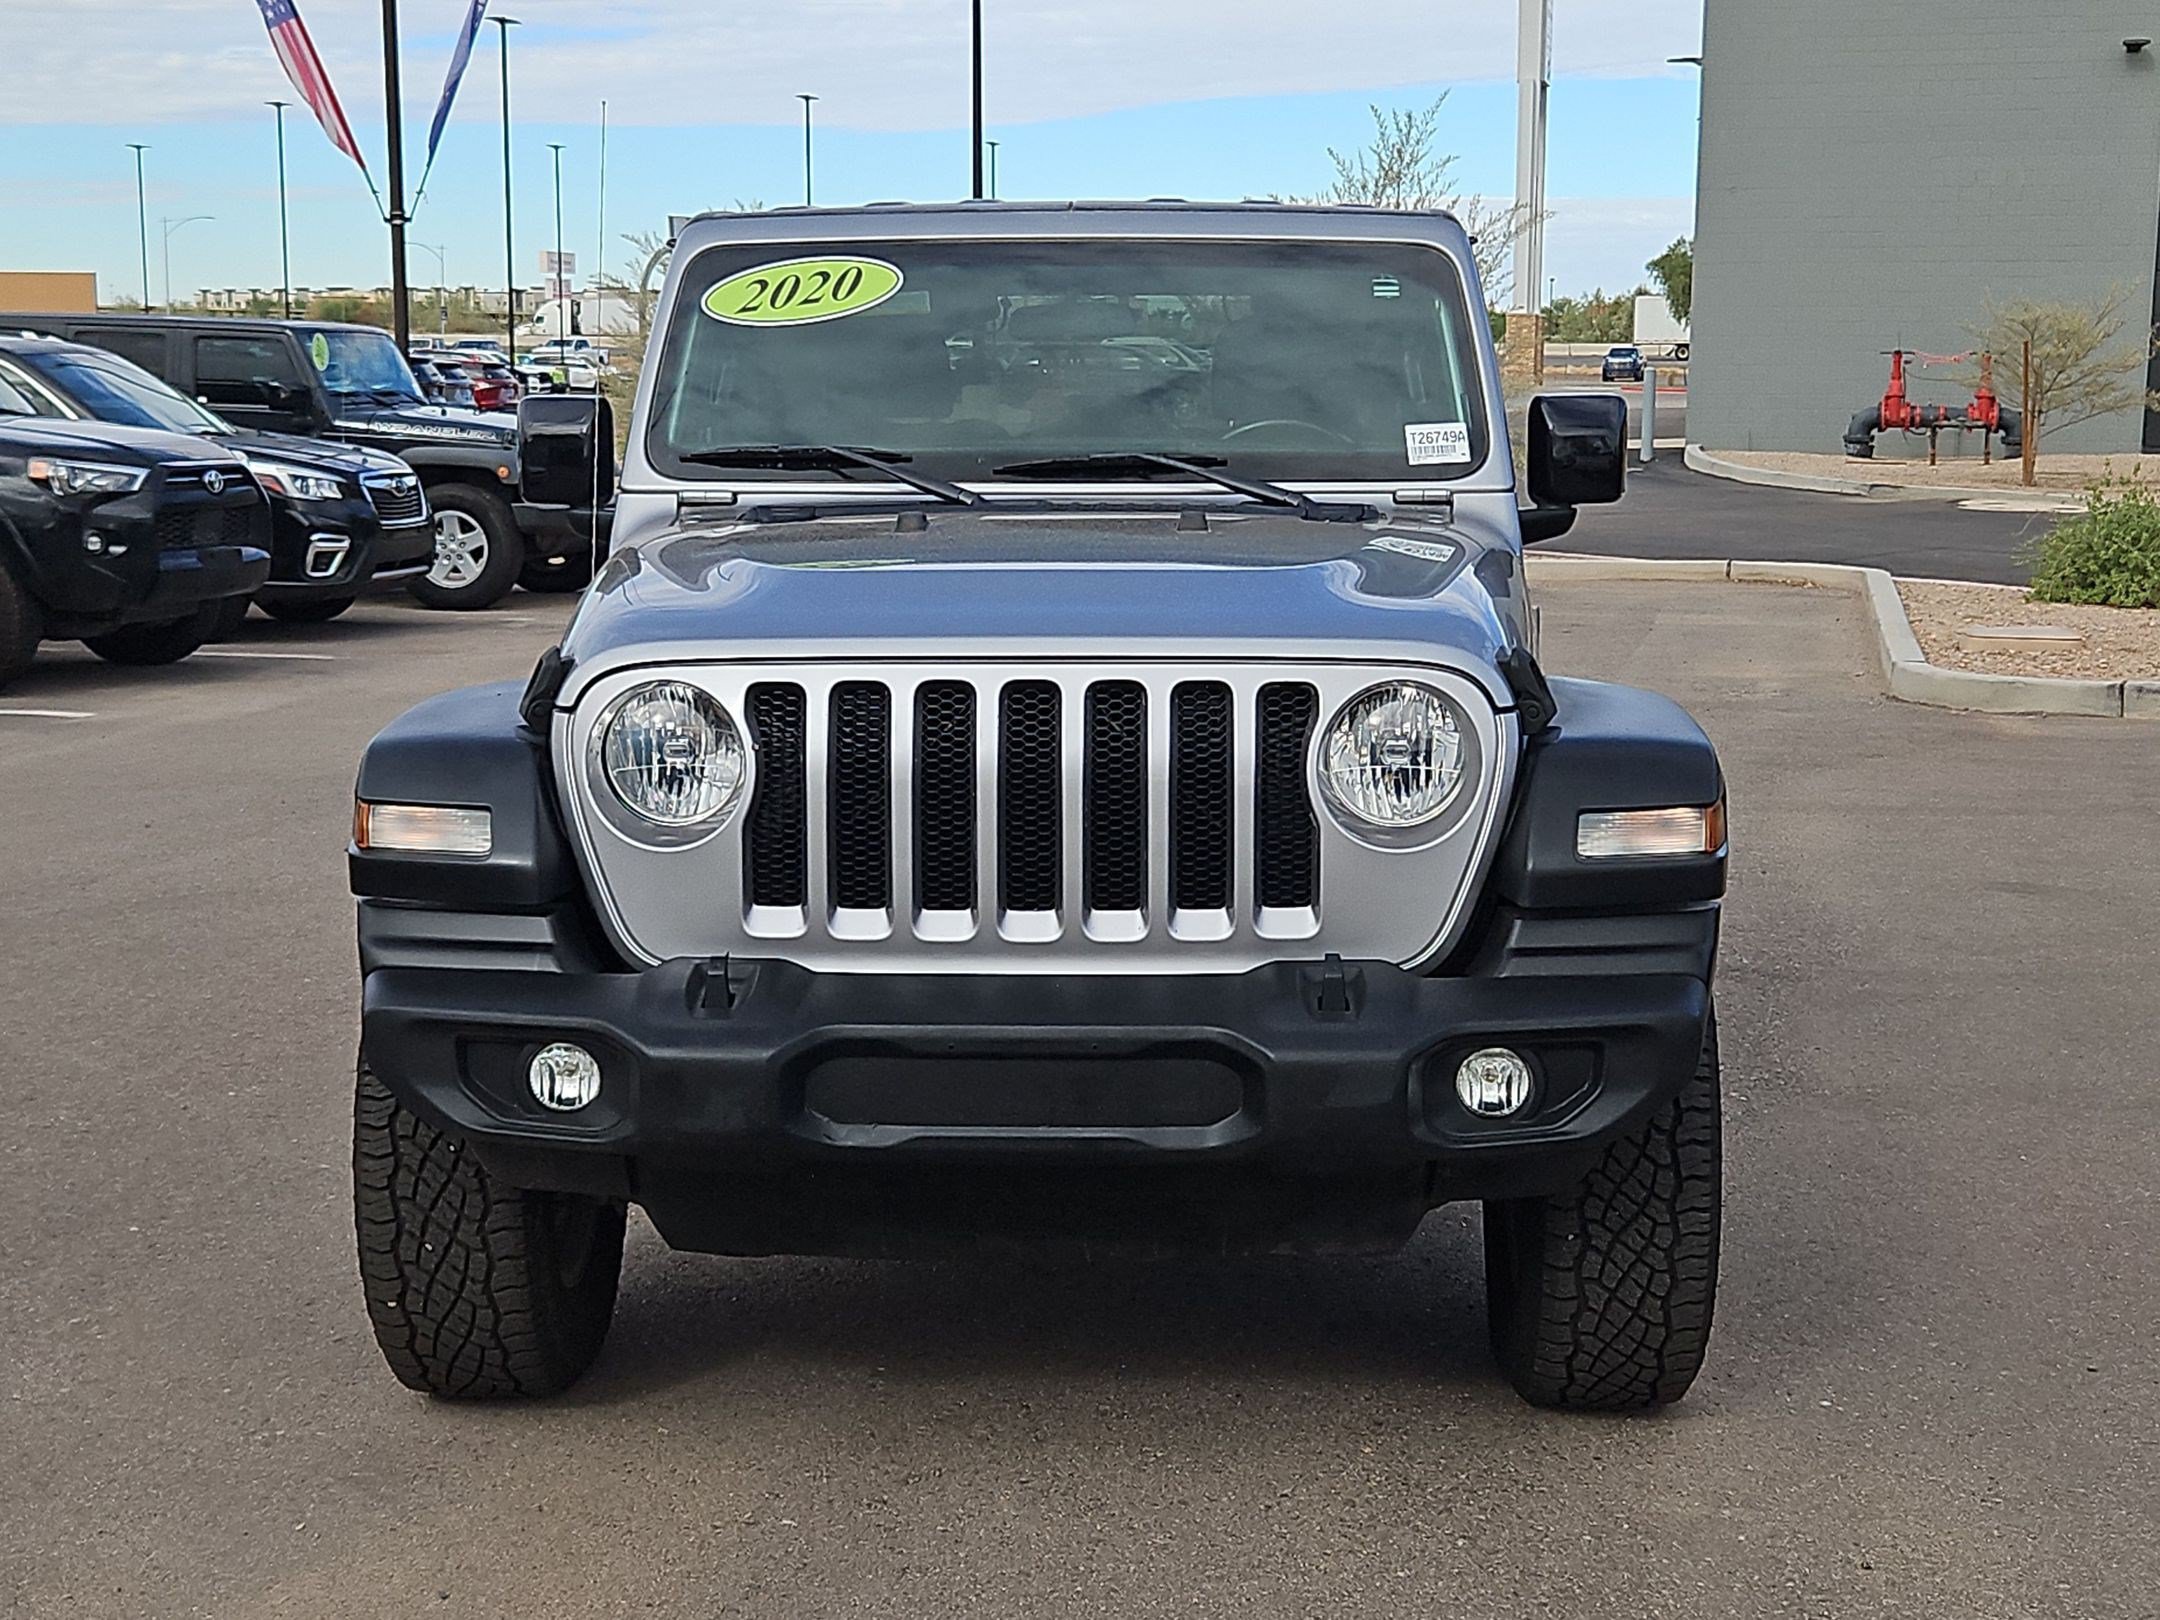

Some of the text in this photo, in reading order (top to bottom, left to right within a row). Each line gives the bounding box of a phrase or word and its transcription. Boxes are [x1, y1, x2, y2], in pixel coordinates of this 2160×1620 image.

[734, 265, 863, 315] 2020
[376, 422, 497, 440] WRANGLER
[1409, 430, 1466, 445] T26749A
